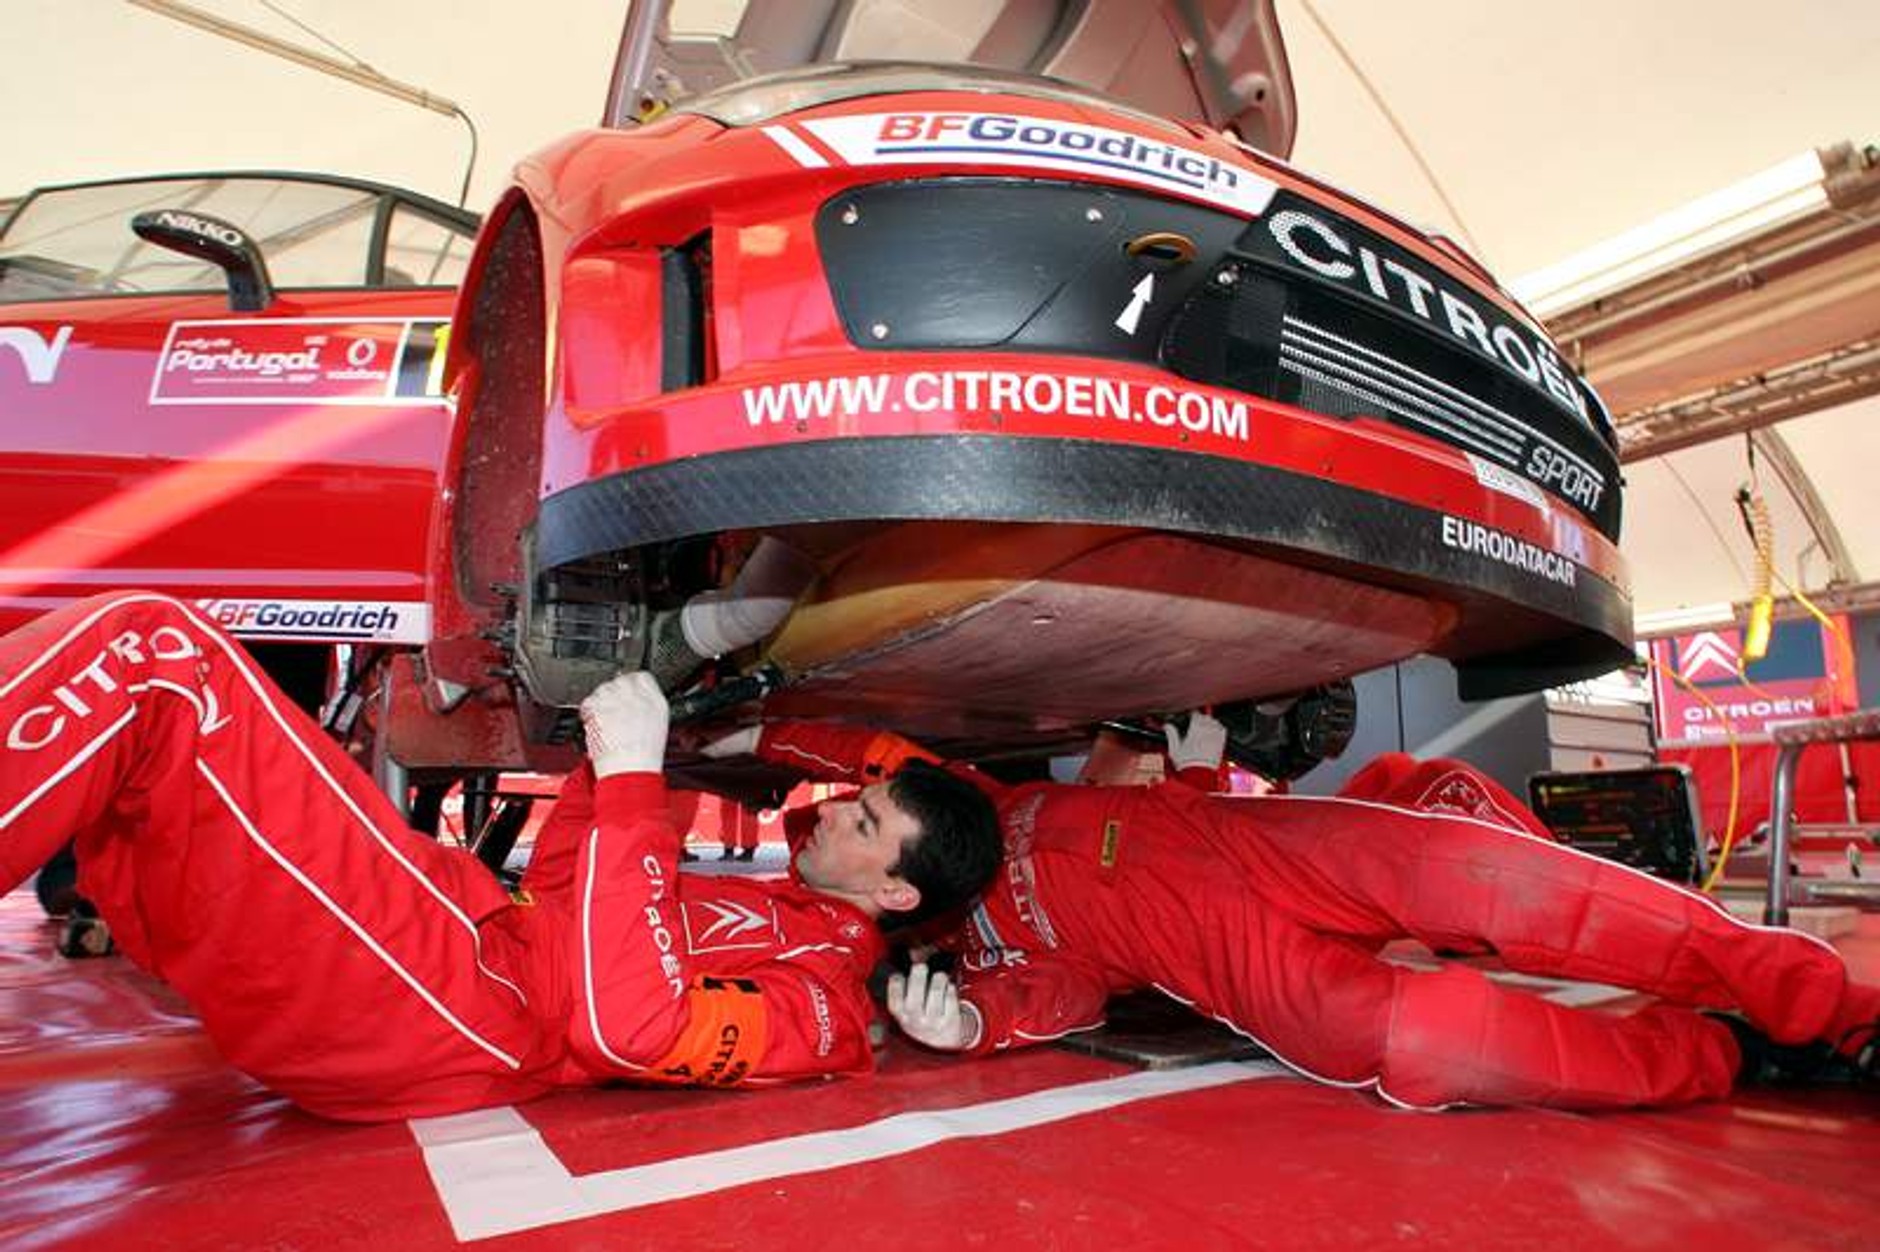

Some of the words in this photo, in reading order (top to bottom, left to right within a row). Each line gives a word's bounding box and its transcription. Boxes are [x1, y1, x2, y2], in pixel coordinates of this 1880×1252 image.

[876, 114, 1238, 189] BFGoodrich
[157, 211, 243, 246] NIKKO
[167, 347, 320, 375] Portugal
[743, 372, 1250, 440] WWW.CITROEN.COM
[1525, 445, 1605, 512] SPORT
[1442, 515, 1577, 586] EURODATACAR
[217, 603, 399, 630] BFGoodrich
